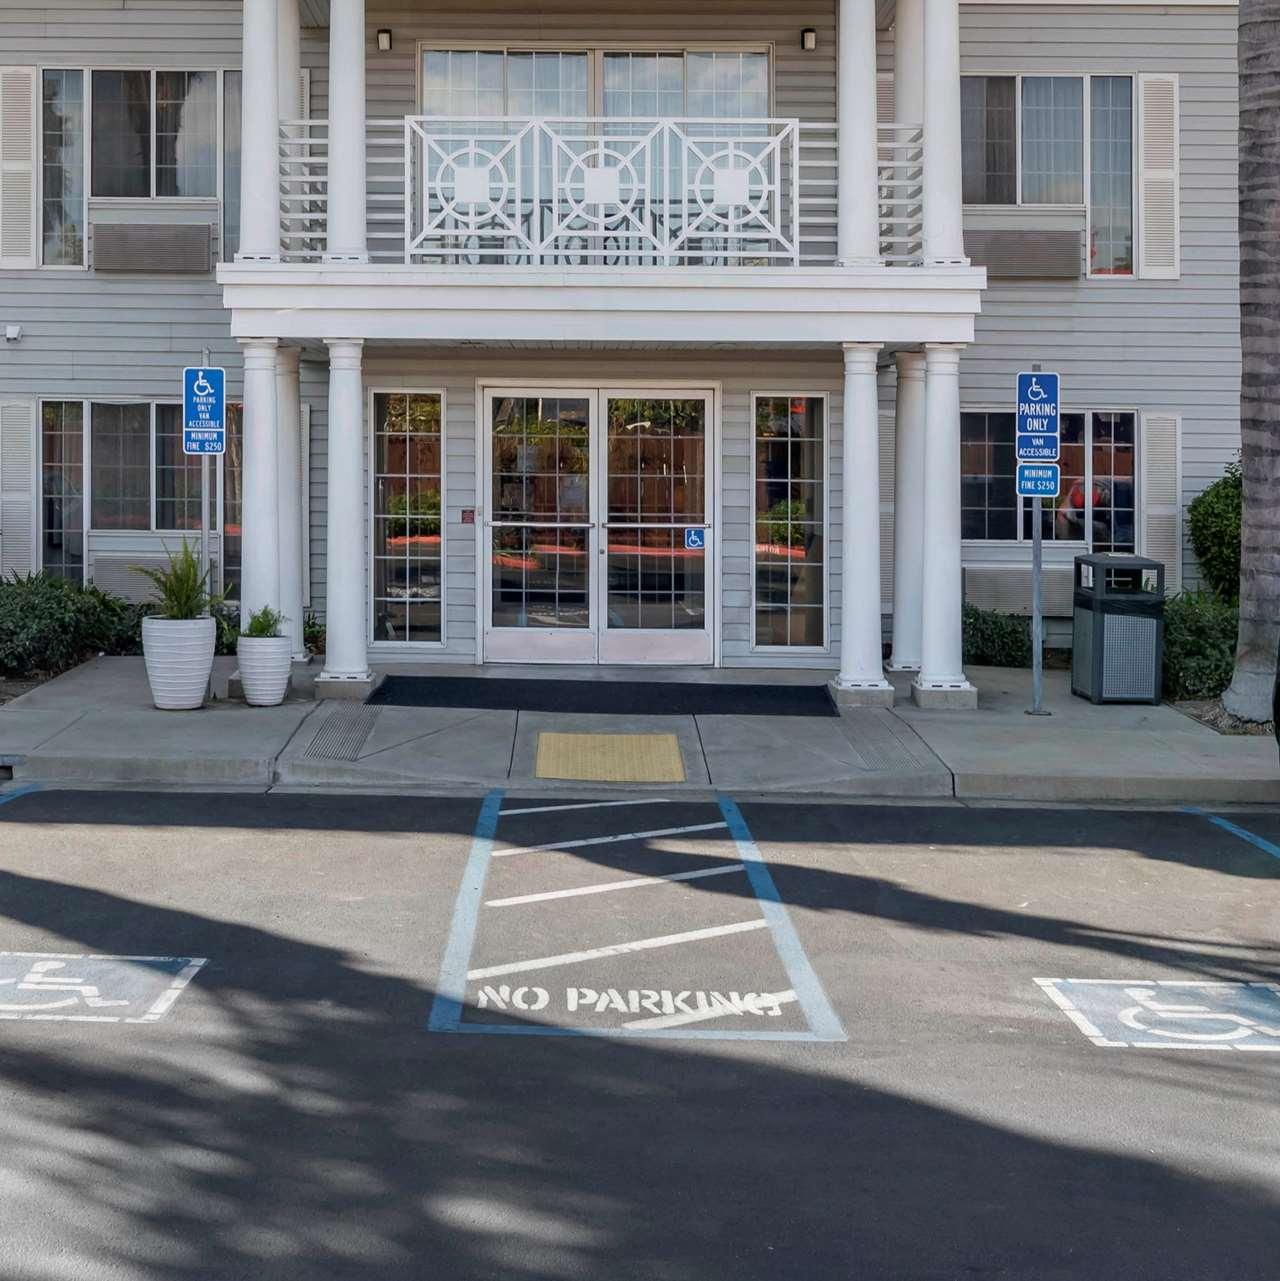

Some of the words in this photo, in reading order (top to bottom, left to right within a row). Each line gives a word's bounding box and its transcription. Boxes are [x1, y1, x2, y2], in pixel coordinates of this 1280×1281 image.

[1020, 403, 1056, 416] PARKING
[188, 420, 220, 428] ACCESSIBLE
[1027, 418, 1048, 431] ONLY
[191, 432, 217, 440] MINIMUM
[186, 442, 200, 450] FINE
[204, 442, 222, 451] $250
[1019, 448, 1057, 457] ACCESSIBLE
[1024, 470, 1052, 478] MINIMUM
[1021, 481, 1035, 490] FINE
[1038, 480, 1055, 490] $250
[477, 985, 550, 1010] NO
[566, 987, 784, 1017] PARKING
